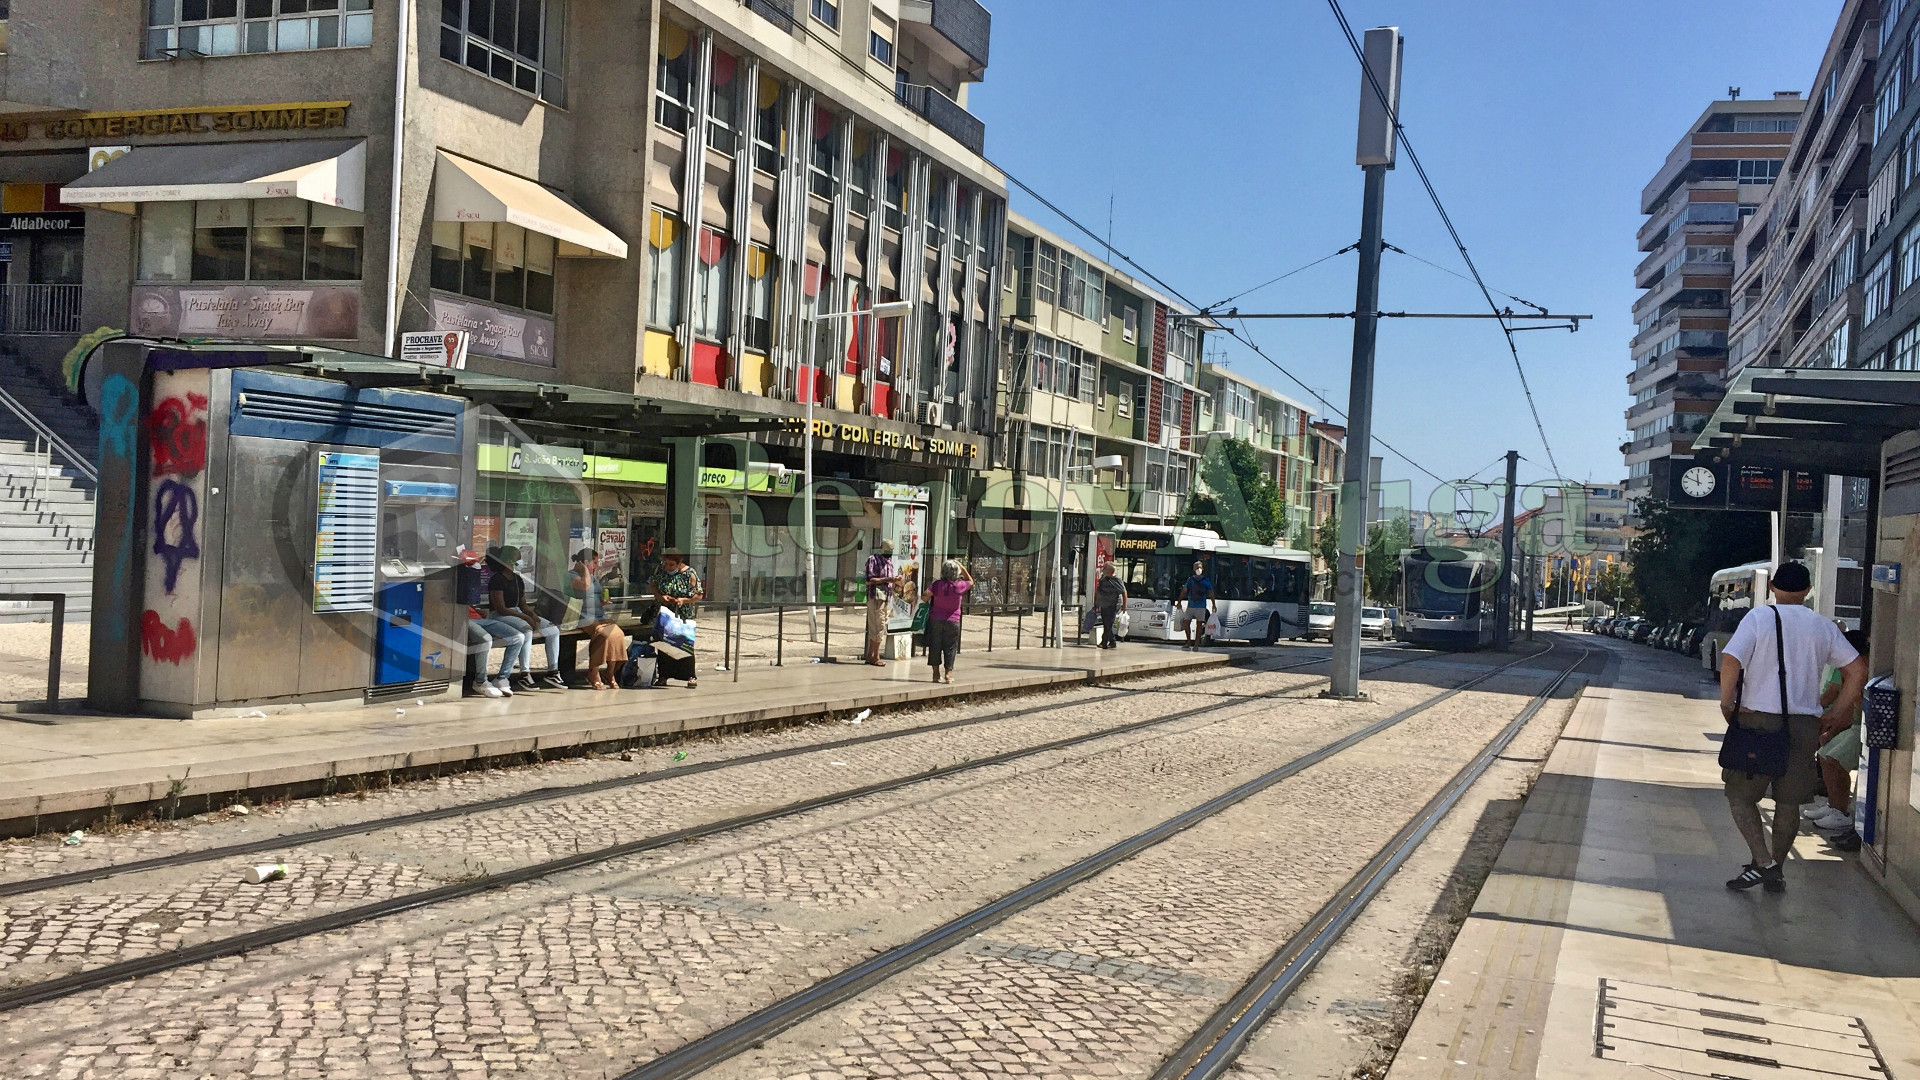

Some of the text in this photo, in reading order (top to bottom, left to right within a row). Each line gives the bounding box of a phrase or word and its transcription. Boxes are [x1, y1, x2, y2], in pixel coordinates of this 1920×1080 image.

[45, 113, 208, 140] COMERCIAL
[212, 107, 346, 132] SOMMER
[9, 217, 71, 230] AldaDecor
[189, 296, 305, 315] Pastelaria Snack Bar
[215, 313, 273, 330] Take Away
[441, 311, 522, 339] Pastelaria Snack Bar
[405, 335, 443, 344] PROCHAVE
[479, 334, 501, 350] Away
[530, 345, 548, 358] SICAL
[701, 472, 726, 485] preço
[600, 531, 626, 543] Cavalo
[1115, 539, 1157, 550] TRAFARIA
